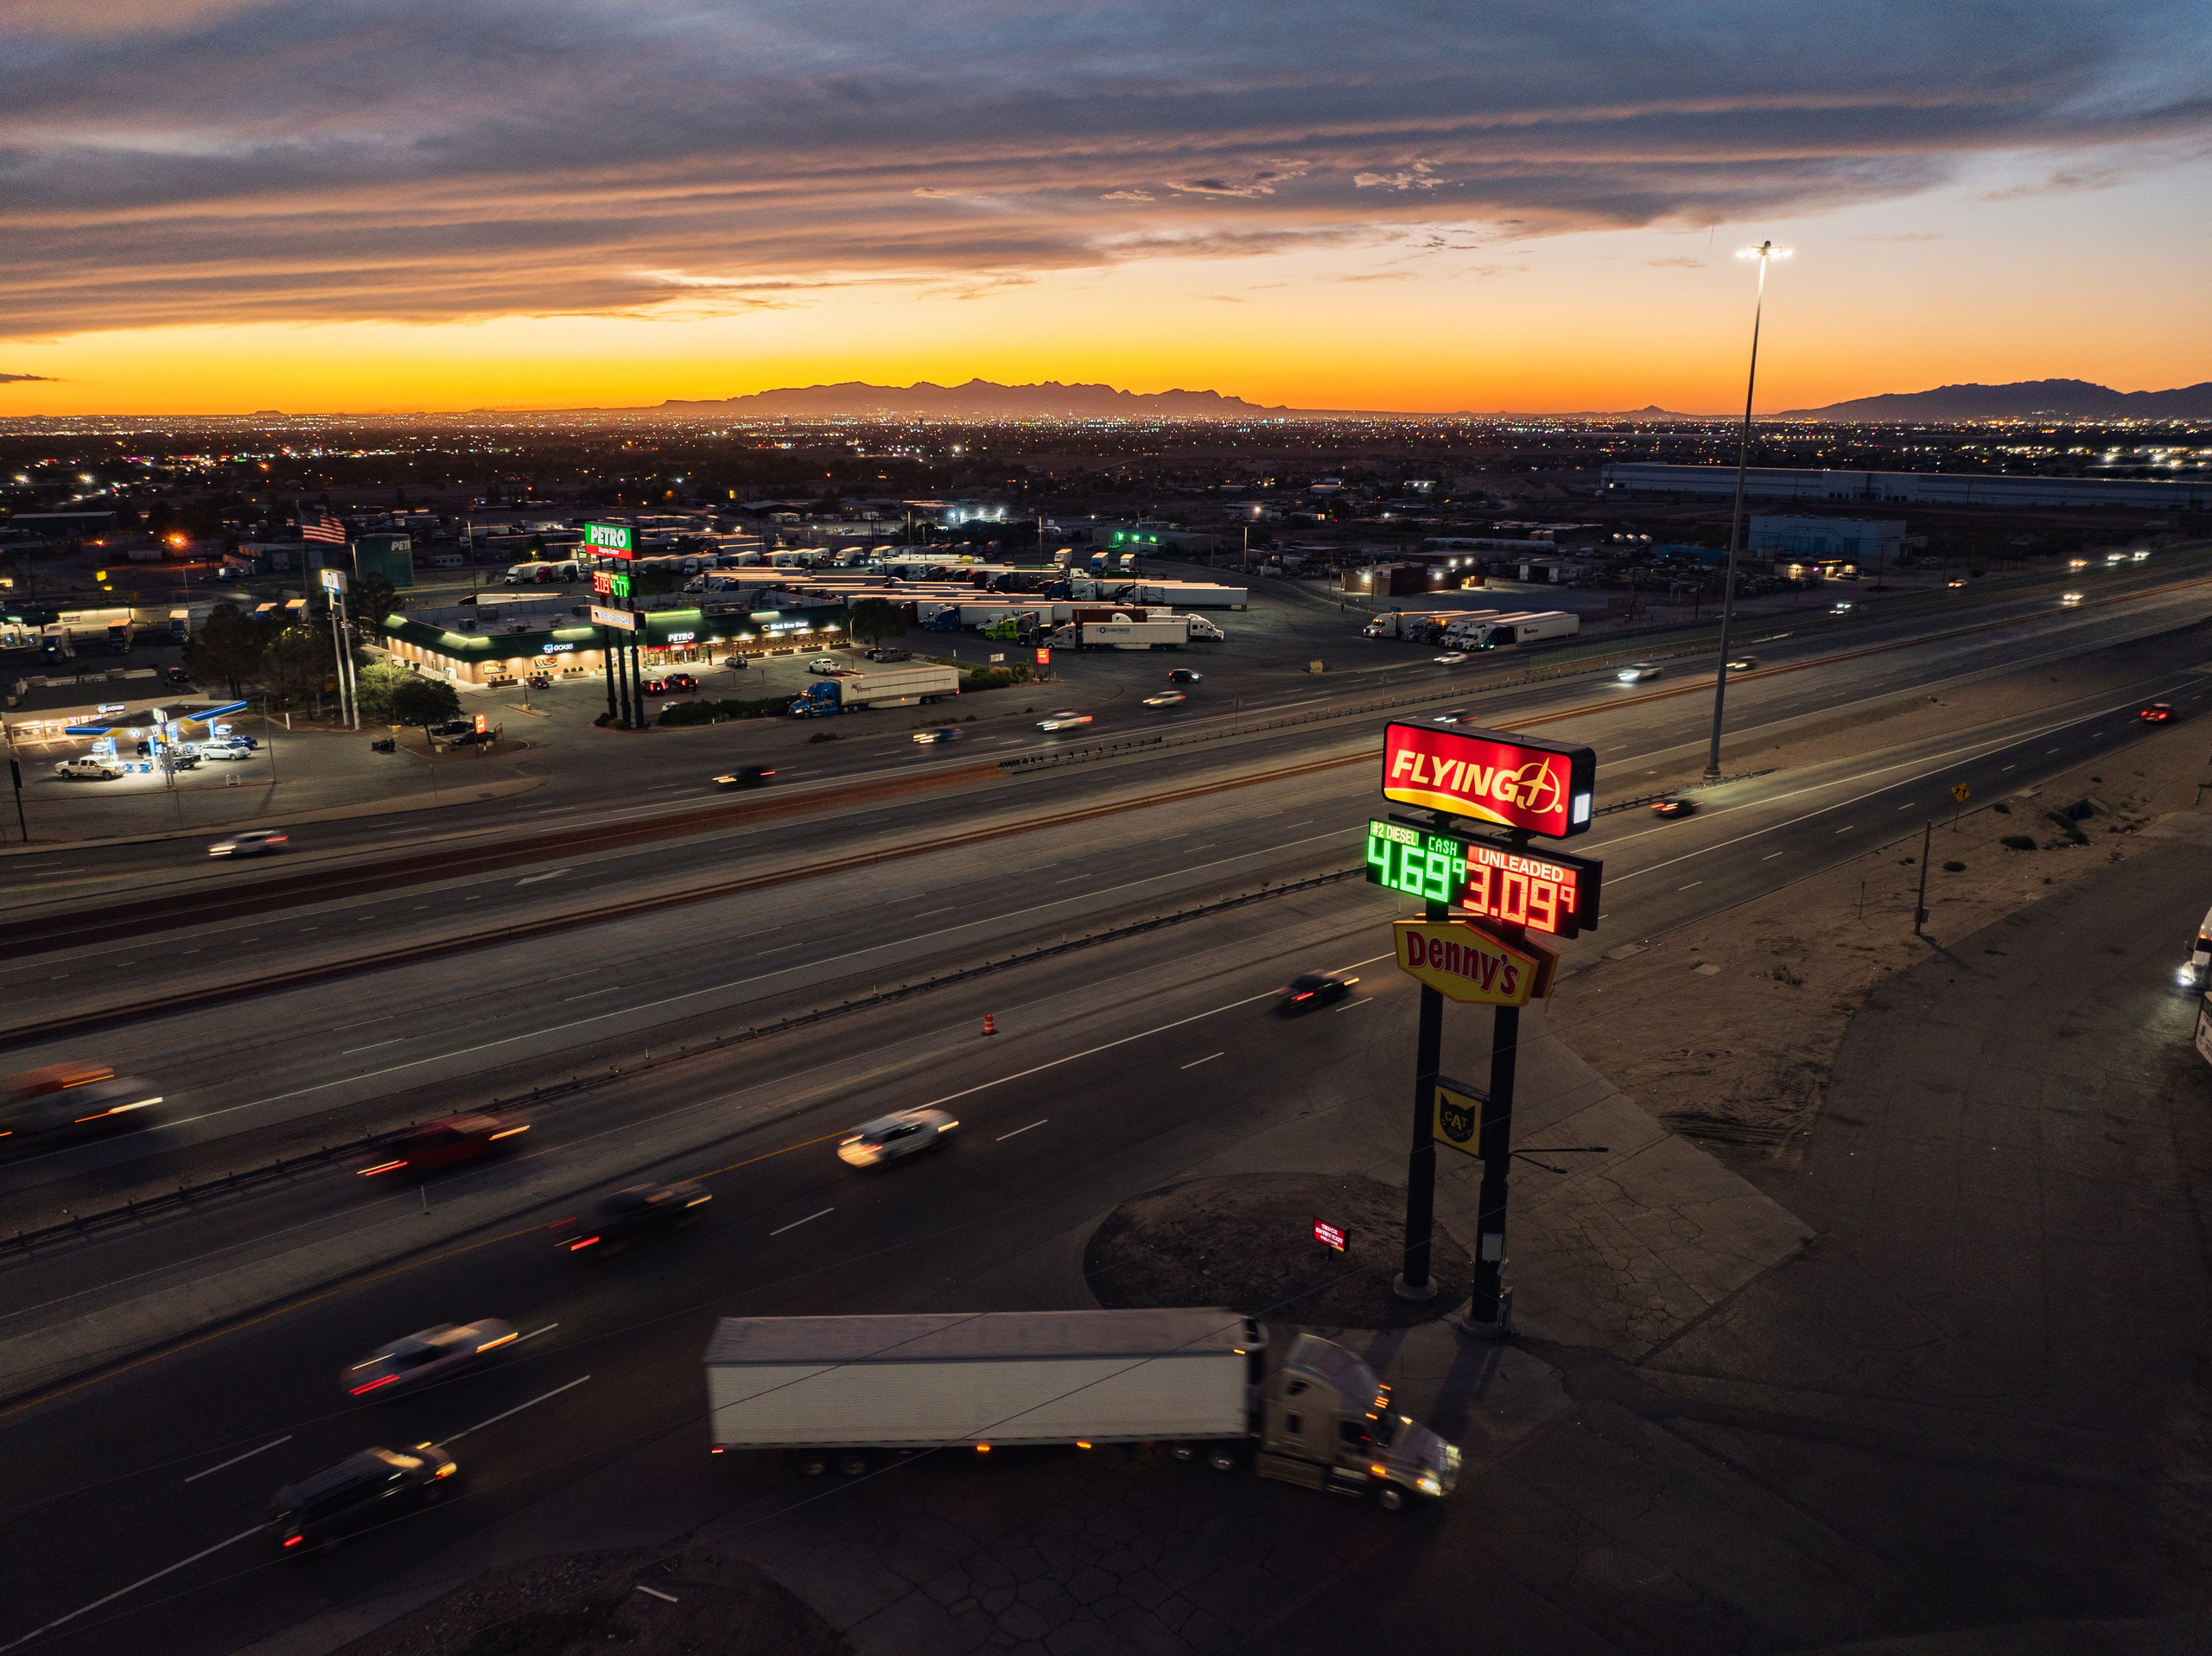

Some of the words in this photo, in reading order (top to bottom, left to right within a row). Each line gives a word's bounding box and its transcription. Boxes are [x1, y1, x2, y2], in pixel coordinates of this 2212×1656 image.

[590, 525, 626, 548] PETRO
[667, 631, 696, 643] PETRO
[1391, 749, 1520, 802] FLYING
[1372, 823, 1385, 837] #2
[1386, 826, 1417, 847] DIESEL
[1428, 835, 1459, 857] CASH
[1478, 847, 1565, 883] UNLEADED
[1406, 930, 1521, 998] Denny's
[1444, 1111, 1468, 1131] CAT
